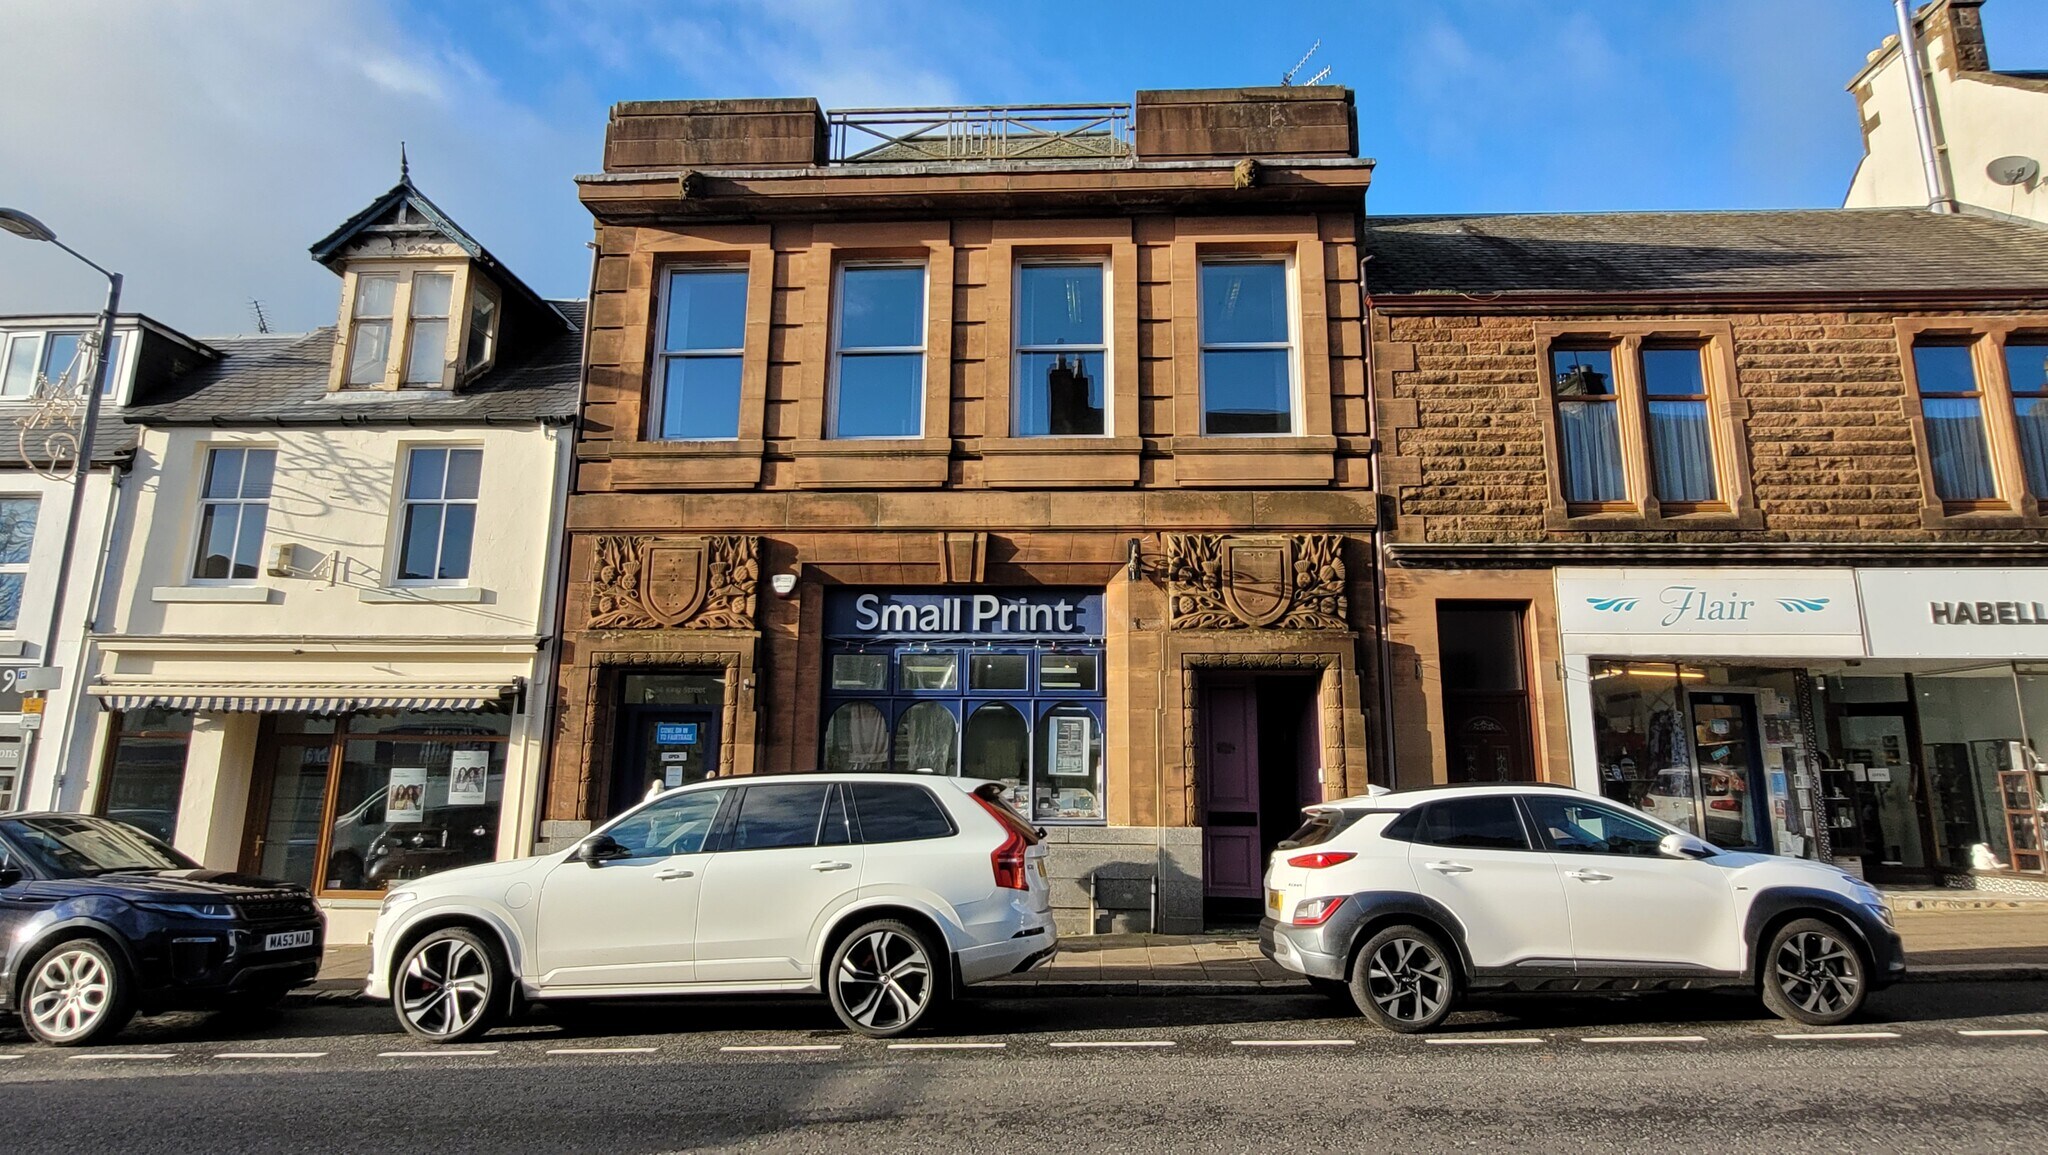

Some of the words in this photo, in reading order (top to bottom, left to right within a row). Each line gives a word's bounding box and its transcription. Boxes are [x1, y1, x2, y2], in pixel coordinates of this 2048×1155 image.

[856, 593, 961, 632] Small
[973, 594, 1074, 631] Print
[1659, 585, 1755, 627] Flair
[1930, 601, 2048, 625] HABELL
[682, 686, 706, 694] Street
[269, 934, 294, 948] MA53
